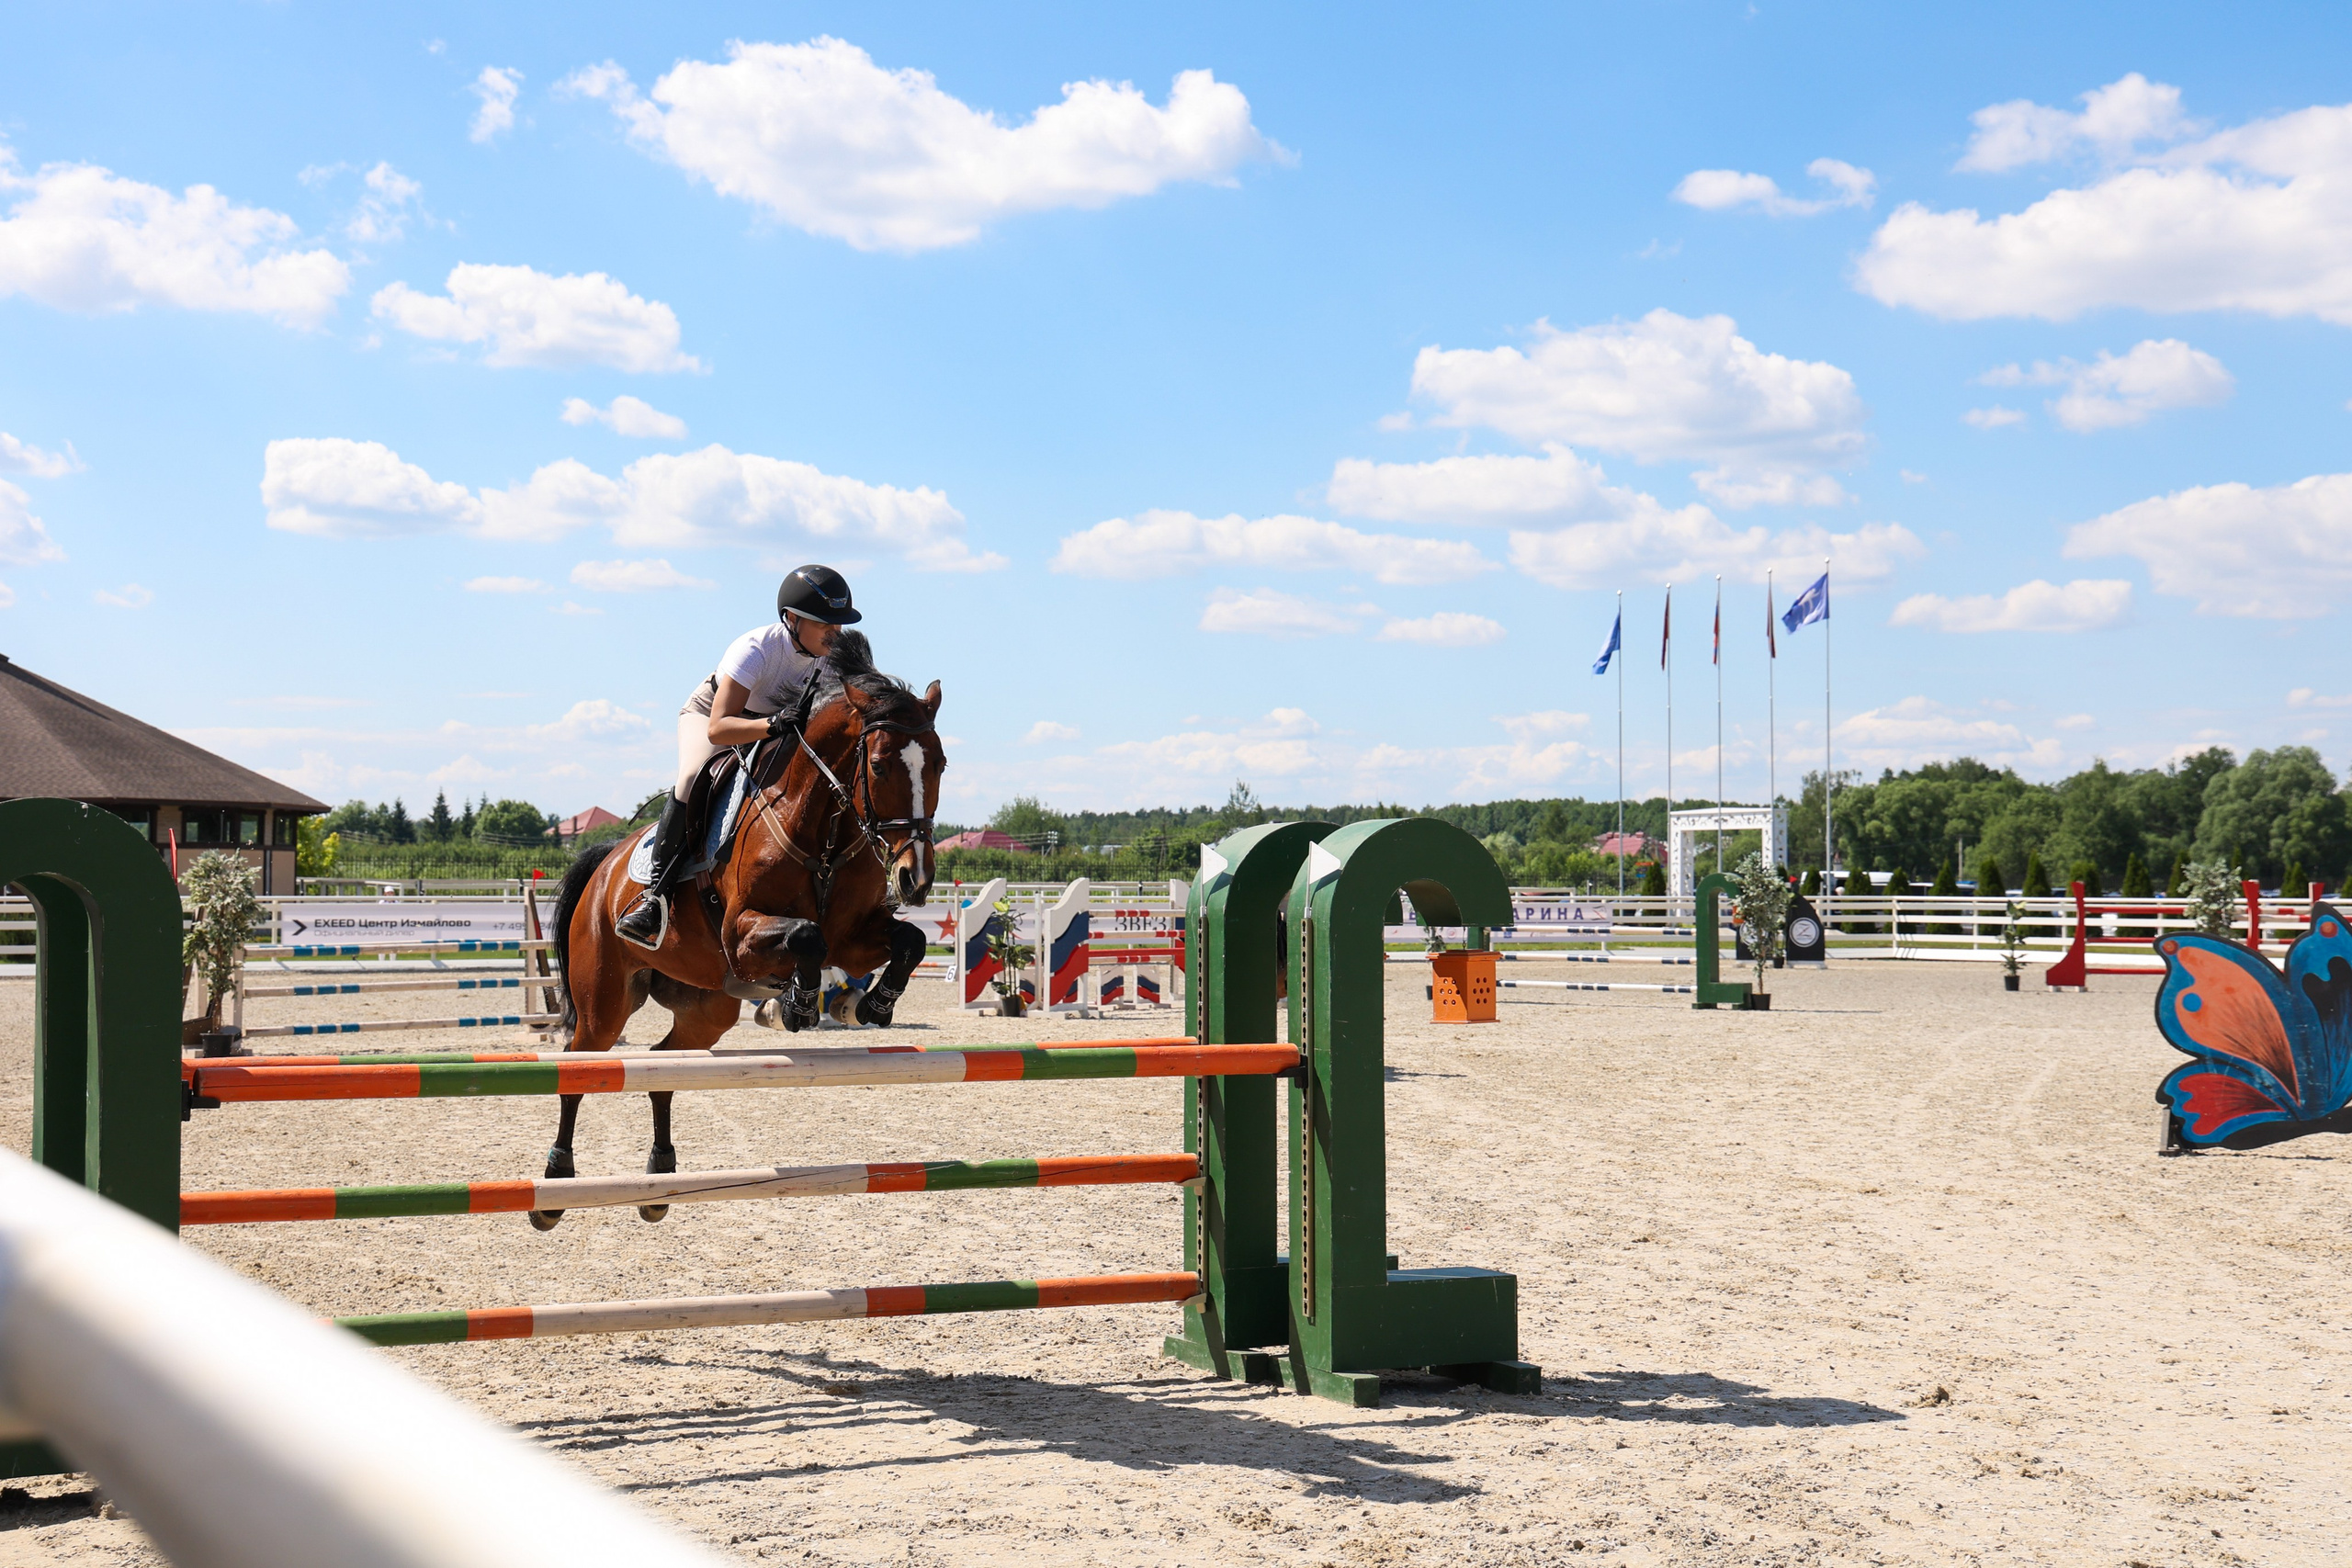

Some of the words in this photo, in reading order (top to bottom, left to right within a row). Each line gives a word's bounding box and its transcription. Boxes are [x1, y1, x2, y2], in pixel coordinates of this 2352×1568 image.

[314, 919, 355, 928] EXEED
[359, 919, 398, 929] Центр
[401, 918, 471, 928] Измайлово
[493, 922, 505, 931] +7
[1114, 917, 1167, 931] ЗВЕЗ
[947, 968, 955, 980] 6
